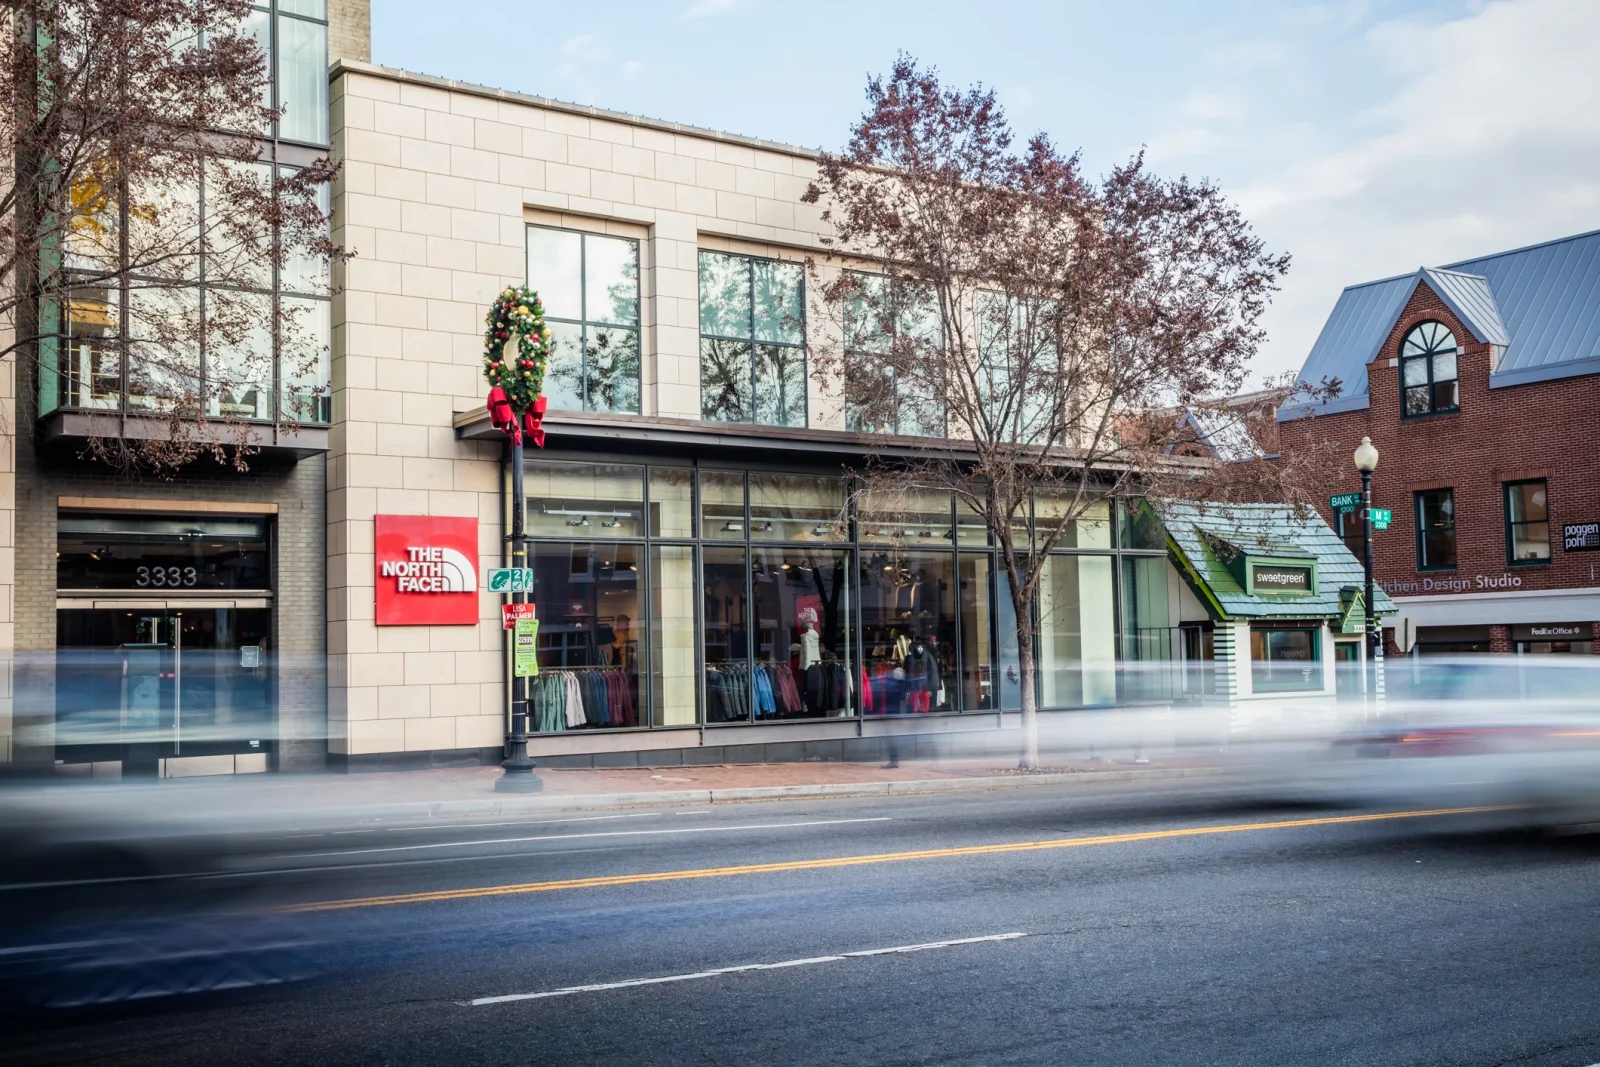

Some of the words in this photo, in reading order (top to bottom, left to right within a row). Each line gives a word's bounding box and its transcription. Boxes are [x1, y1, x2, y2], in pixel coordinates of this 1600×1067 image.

[1331, 495, 1353, 507] BANK
[1375, 511, 1382, 520] M
[1565, 524, 1599, 537] poggen
[1565, 536, 1585, 549] pohl
[407, 547, 441, 561] THE
[382, 561, 441, 576] NORTH
[514, 570, 521, 578] 2
[136, 566, 197, 586] 3333
[1257, 573, 1304, 584] sweetgreen
[1377, 579, 1418, 592] itchen
[1424, 577, 1471, 592] Design
[1476, 573, 1521, 588] Studio
[398, 577, 441, 592] FACE
